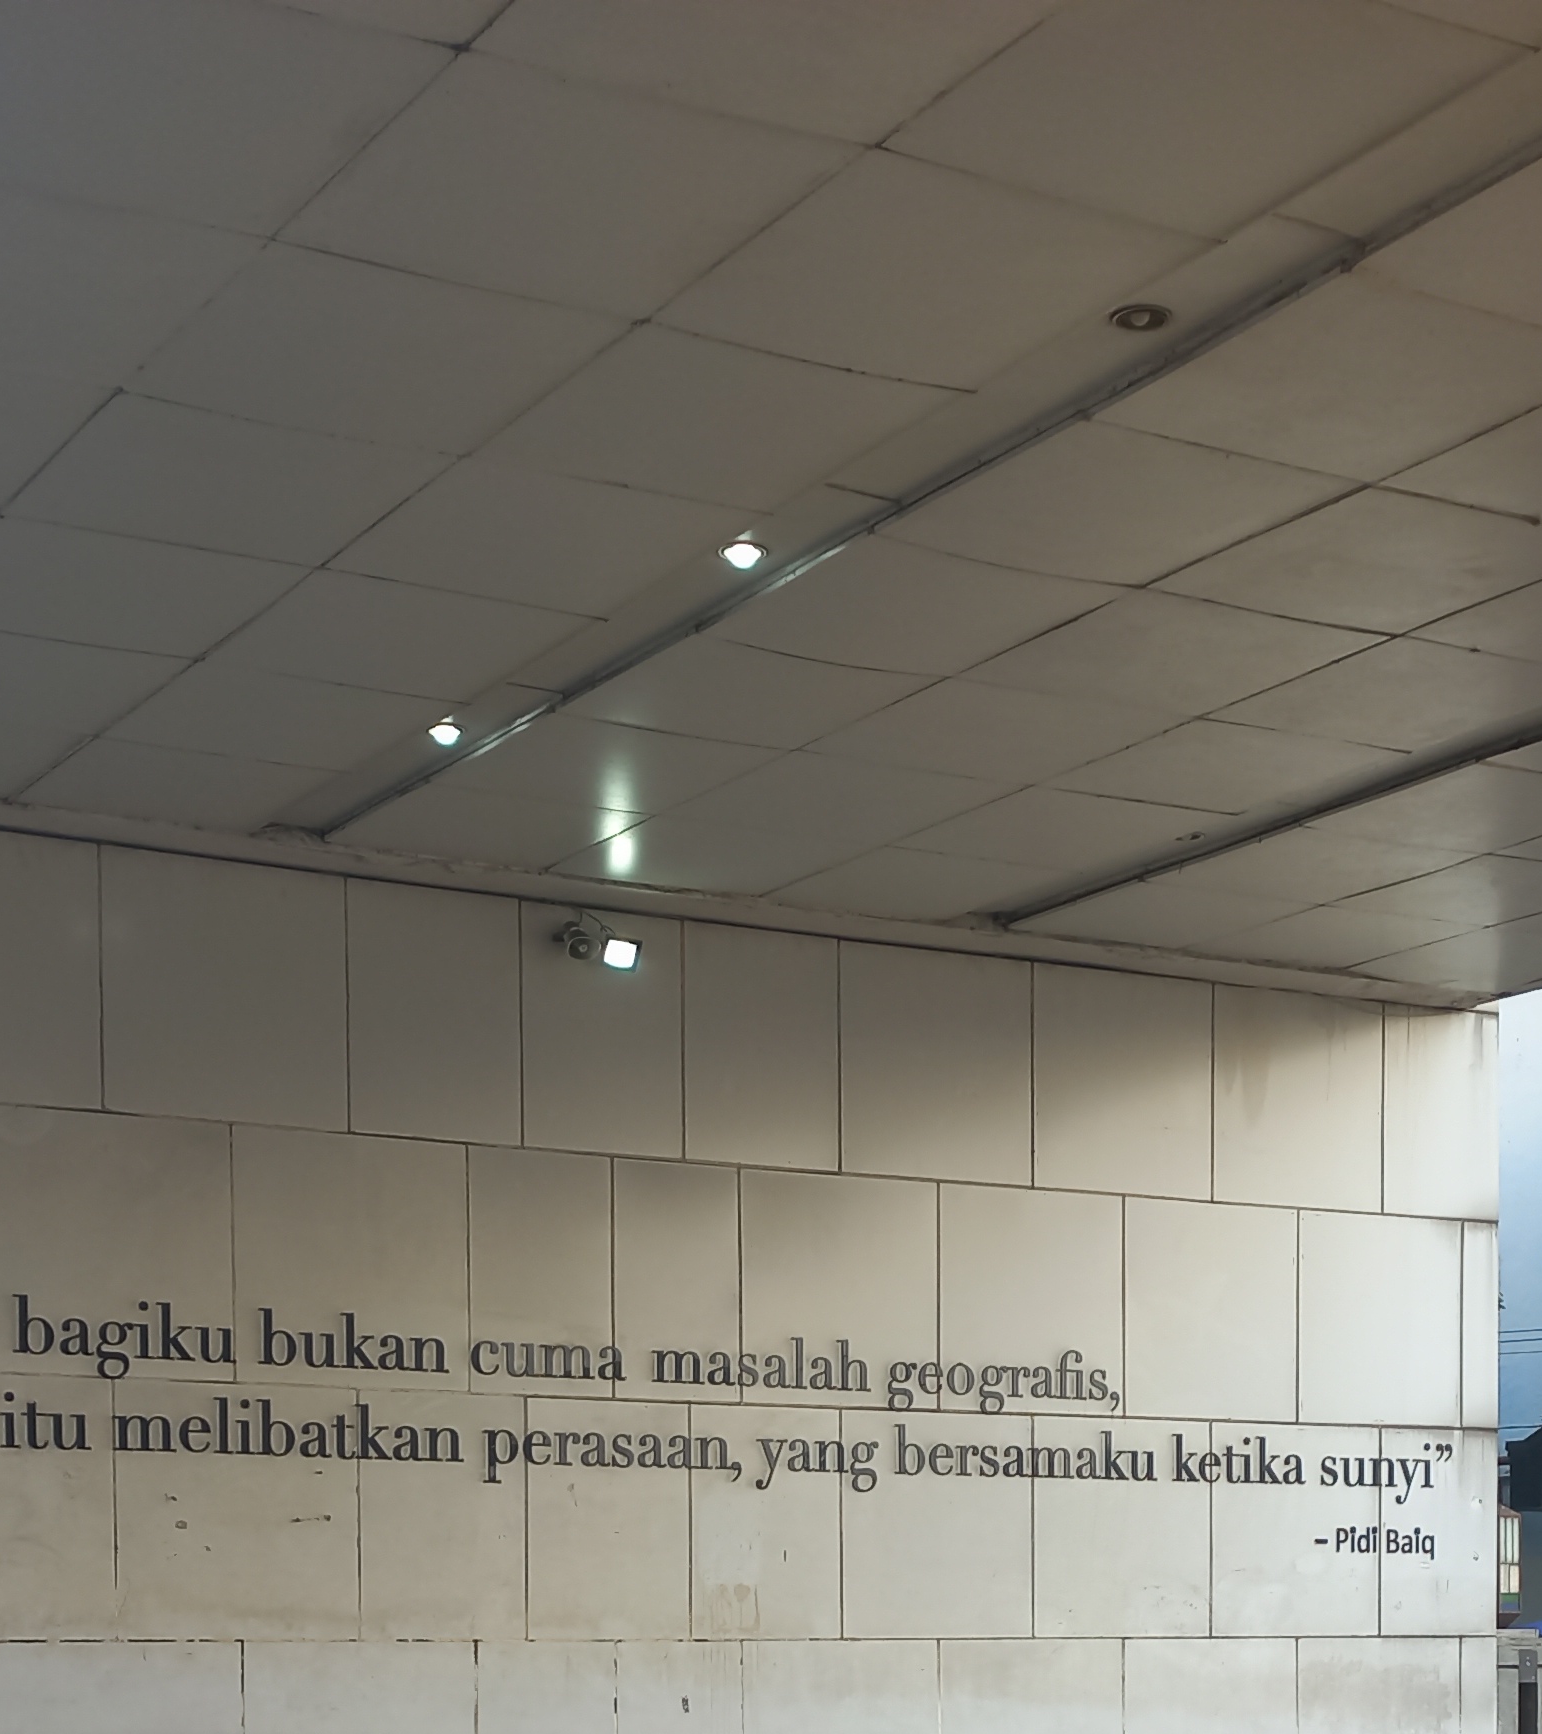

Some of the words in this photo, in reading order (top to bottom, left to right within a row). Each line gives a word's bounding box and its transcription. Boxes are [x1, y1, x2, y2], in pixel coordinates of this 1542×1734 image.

[14, 1294, 235, 1379] bagiku
[257, 1307, 448, 1374] bukan
[471, 1346, 622, 1383] cuma
[651, 1336, 871, 1392] masalah
[886, 1350, 1122, 1413] geografis,
[112, 1396, 463, 1462] melibatkan
[482, 1424, 742, 1485] perasaan,
[755, 1437, 877, 1495] yang
[894, 1424, 1156, 1482] bersamaku
[1171, 1436, 1304, 1486] ketika
[1335, 1526, 1378, 1553] Pidi
[1386, 1527, 1435, 1560] Baiq
